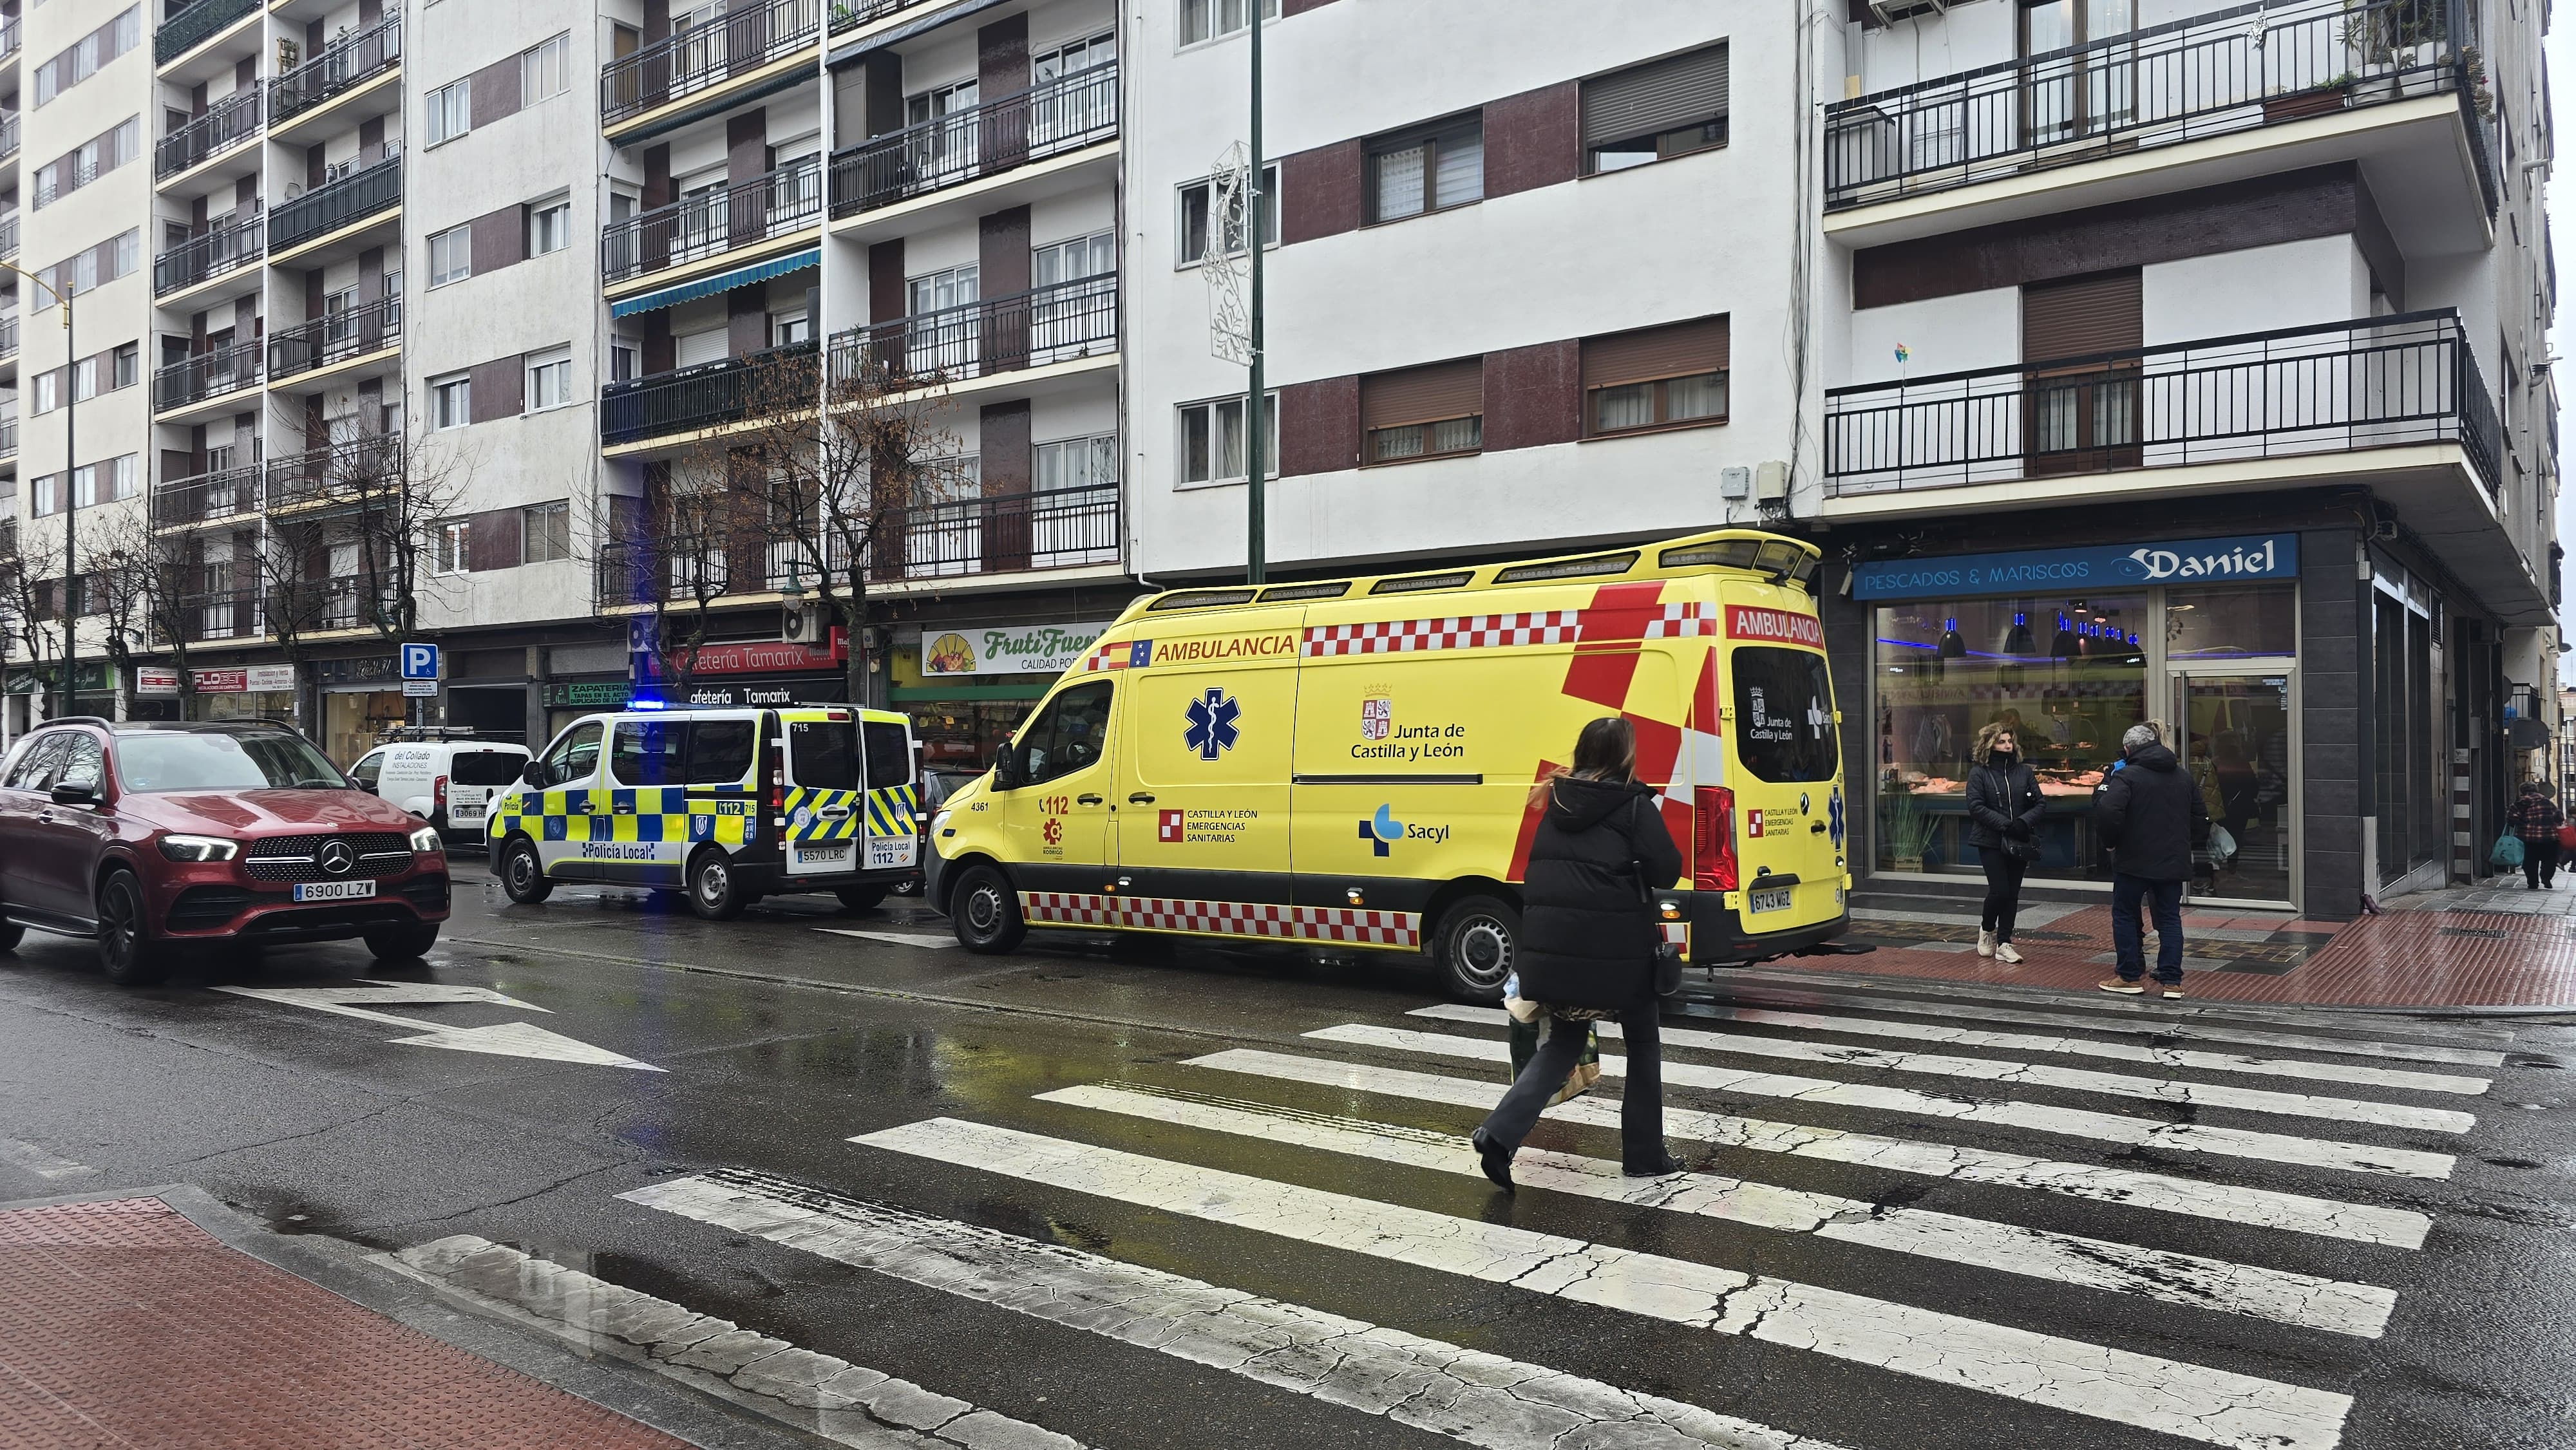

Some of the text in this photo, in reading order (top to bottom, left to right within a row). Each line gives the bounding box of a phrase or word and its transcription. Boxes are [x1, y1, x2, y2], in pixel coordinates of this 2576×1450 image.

[2137, 540, 2275, 579] Daniel
[1865, 561, 2090, 590] PESCADOS & MARISCOS
[1736, 611, 1821, 644] AMBULANCIA
[1155, 635, 1294, 662] AMBULANCIA
[410, 648, 431, 675] P
[743, 646, 804, 668] Tamarix
[1021, 659, 1057, 670] CALIDAD
[571, 685, 629, 699] ZAPATERIA
[690, 687, 790, 704] afetería Tamarix
[792, 724, 809, 732] 715
[1767, 717, 1792, 728] Junta de
[1394, 724, 1464, 739] Junta de
[1750, 728, 1793, 742] Castilla y León
[395, 751, 430, 760] del Collado
[1351, 743, 1463, 762] Castilla y León
[722, 802, 741, 814] 112
[745, 805, 755, 813] 715
[971, 802, 989, 811] 4361
[1046, 796, 1068, 814] 112
[1235, 809, 1258, 818] LEÓN
[1187, 822, 1245, 831] EMERGENCIAS
[1765, 818, 1794, 827] EMERGENCIAS
[1187, 834, 1235, 843] SANITARIAS
[1408, 824, 1449, 843] Sacyl
[1765, 828, 1790, 836] SANITARIAS
[588, 843, 649, 860] Policía Local
[872, 841, 910, 851] Policía Local
[804, 850, 845, 860] 5570 LRC
[876, 852, 894, 863] 112
[305, 882, 373, 898] 6900 LZW
[1755, 890, 1790, 910] 6743 MGZ
